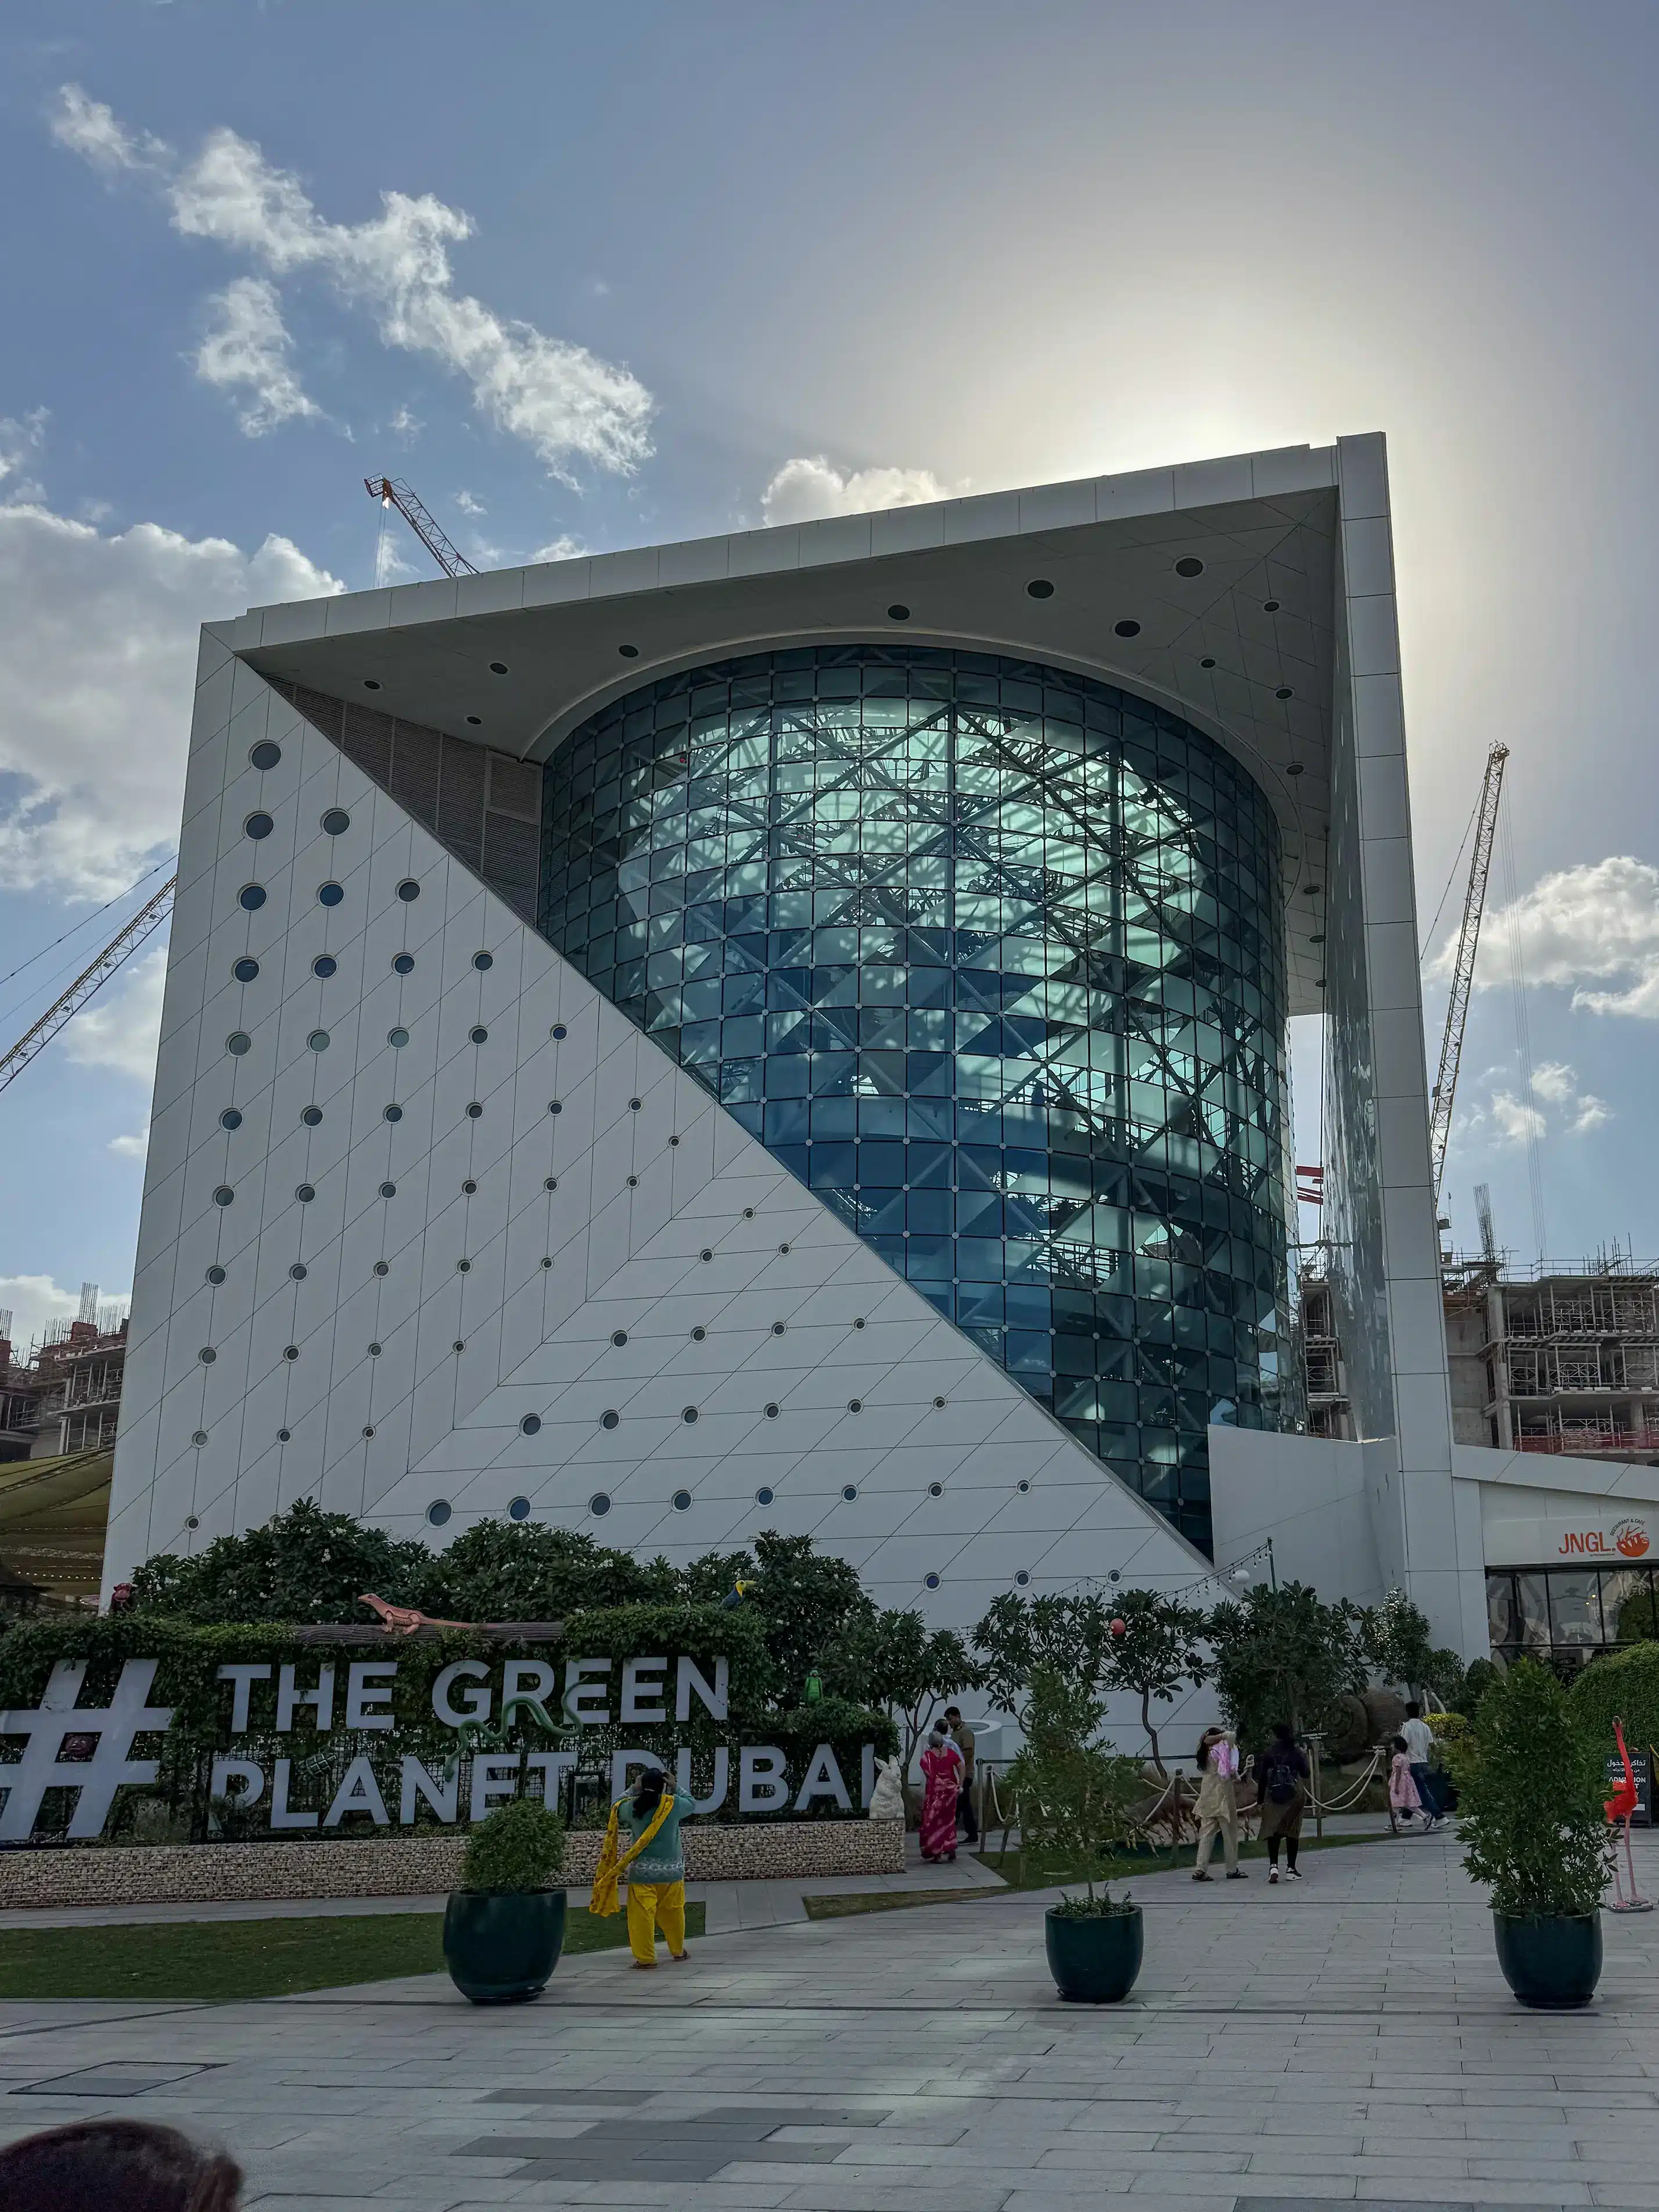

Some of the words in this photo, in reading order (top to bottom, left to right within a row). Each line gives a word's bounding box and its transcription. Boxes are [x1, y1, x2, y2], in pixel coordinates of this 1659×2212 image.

[1559, 1532, 1616, 1554] JNGL.
[1610, 1518, 1629, 1536] RESTAURANT
[217, 1662, 398, 1732] THE
[432, 1656, 729, 1728] GREEN
[208, 1751, 578, 1830] PLANET
